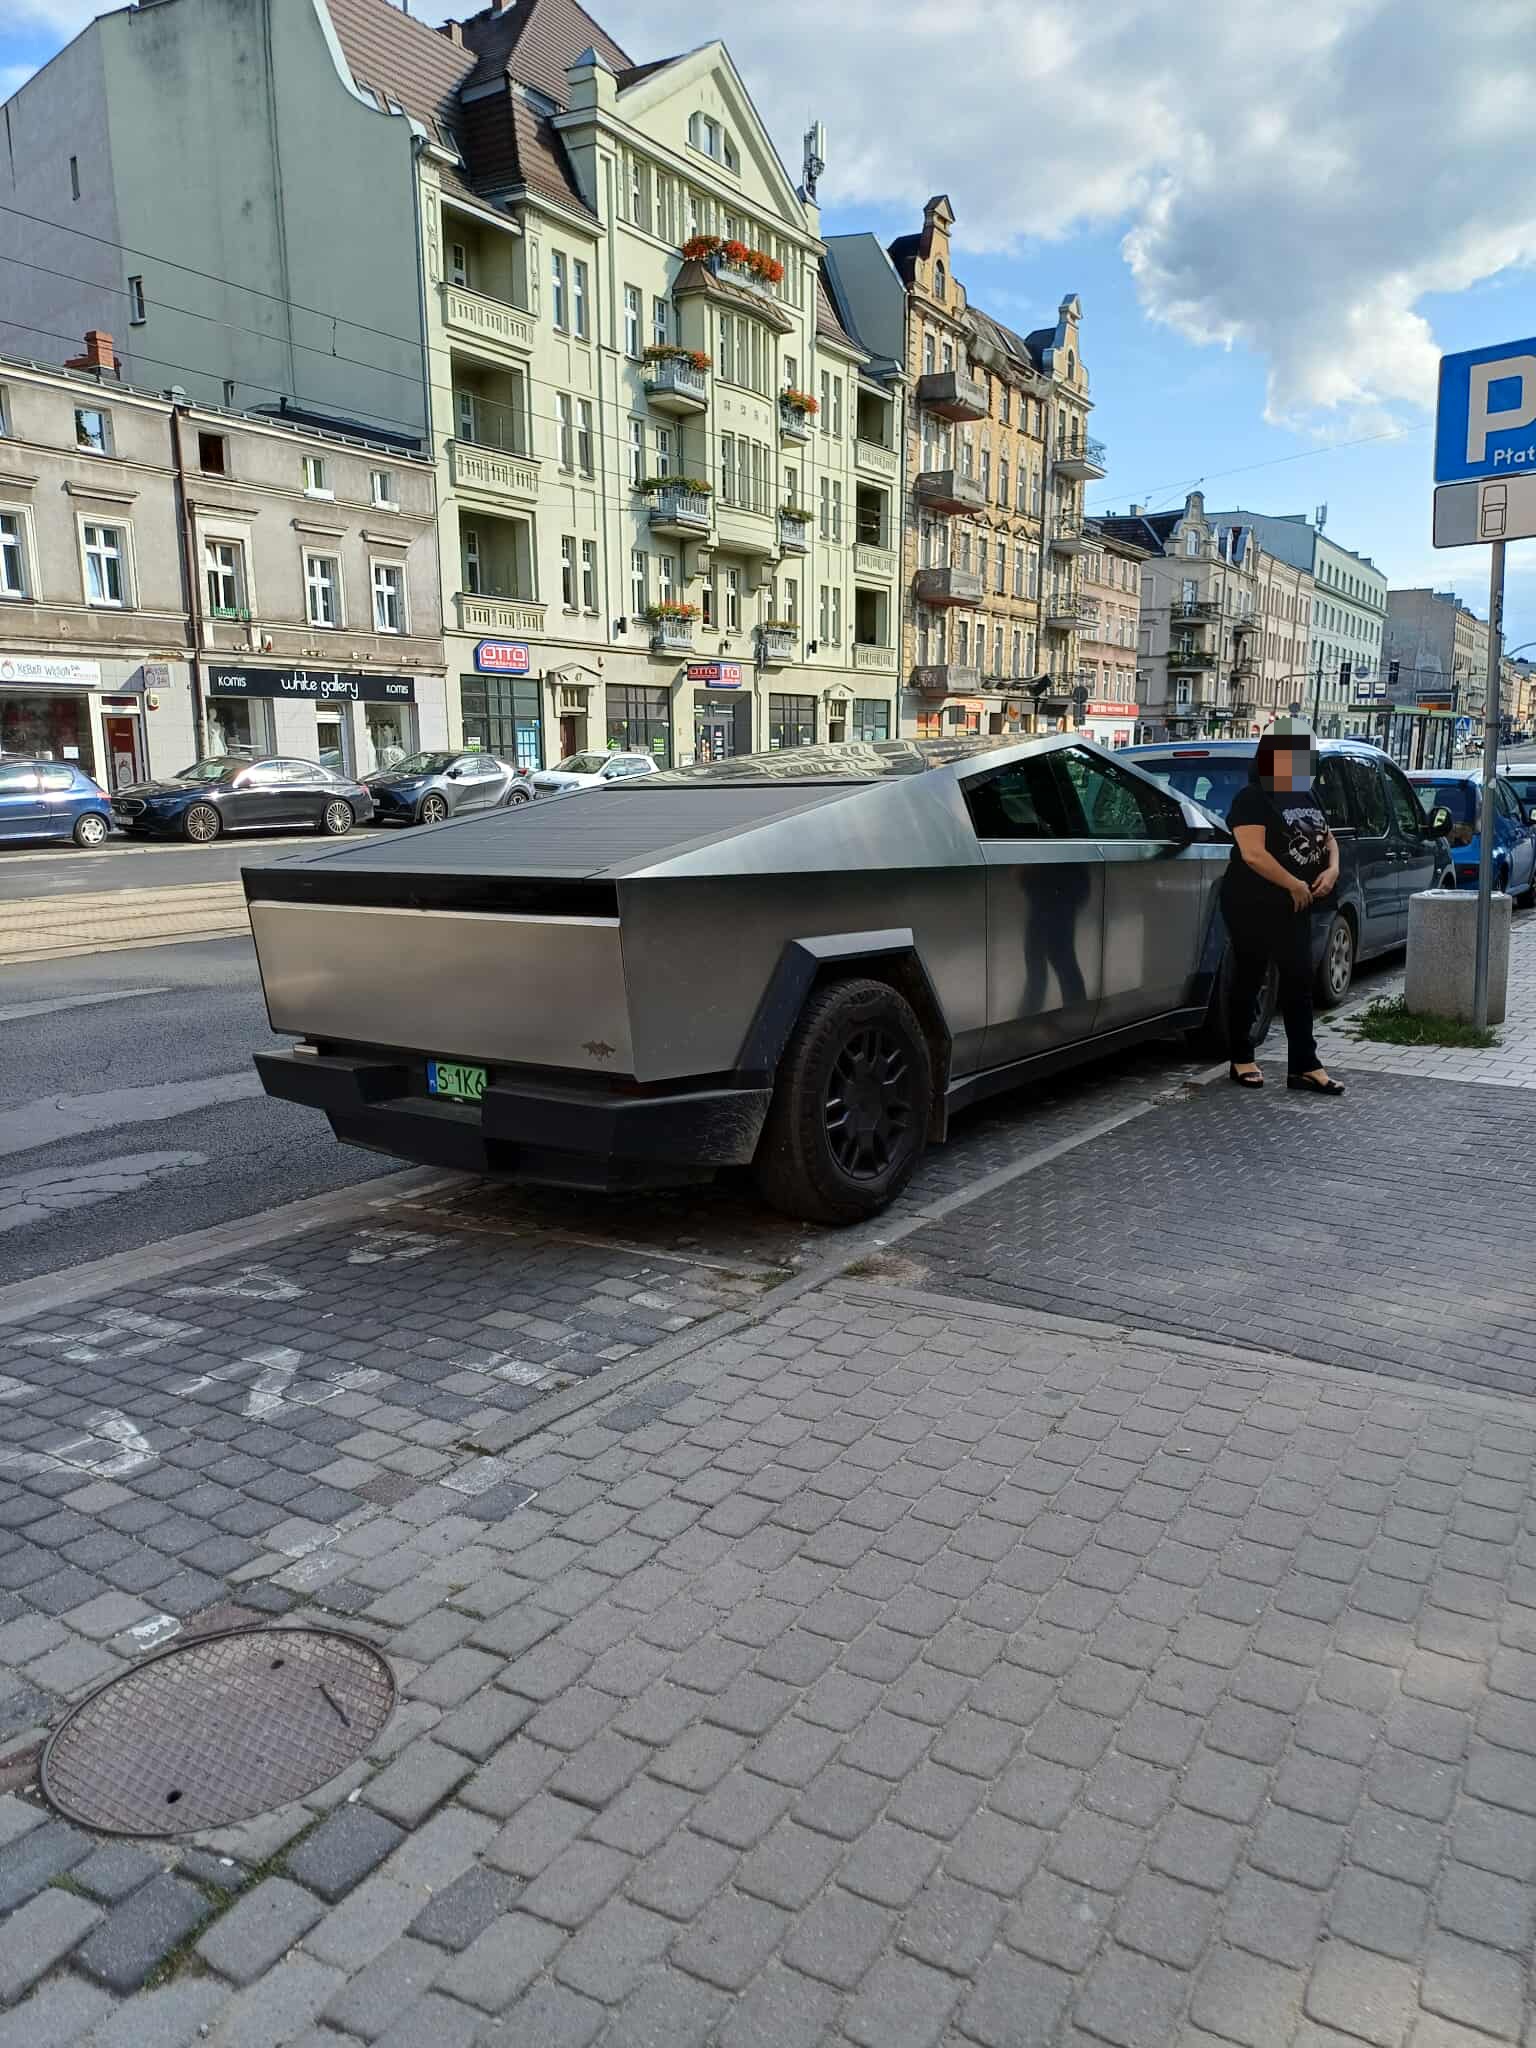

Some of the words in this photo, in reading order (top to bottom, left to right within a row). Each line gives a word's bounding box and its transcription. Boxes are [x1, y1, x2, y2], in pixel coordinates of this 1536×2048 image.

[1467, 356, 1536, 464] P
[483, 646, 526, 661] OTTO
[281, 671, 318, 692] white
[321, 673, 359, 700] gallery
